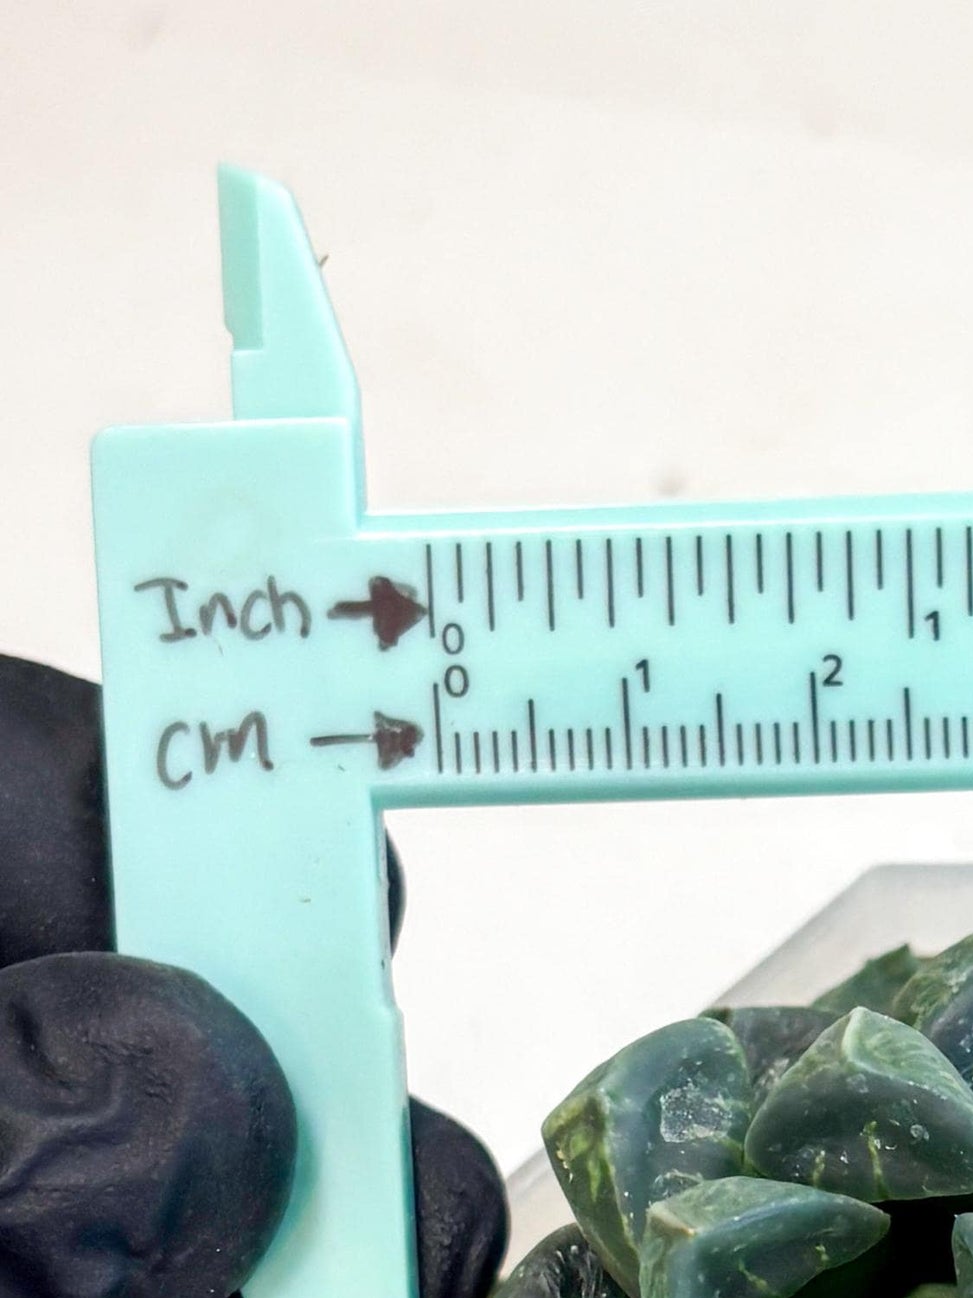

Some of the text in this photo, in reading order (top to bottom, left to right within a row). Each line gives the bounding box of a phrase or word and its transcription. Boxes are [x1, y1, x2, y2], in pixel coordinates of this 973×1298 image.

[133, 575, 312, 643] Inch
[442, 622, 465, 656] 0
[924, 610, 941, 642] 1
[443, 664, 470, 698] 0
[635, 658, 651, 693] 1
[822, 653, 844, 688] 2
